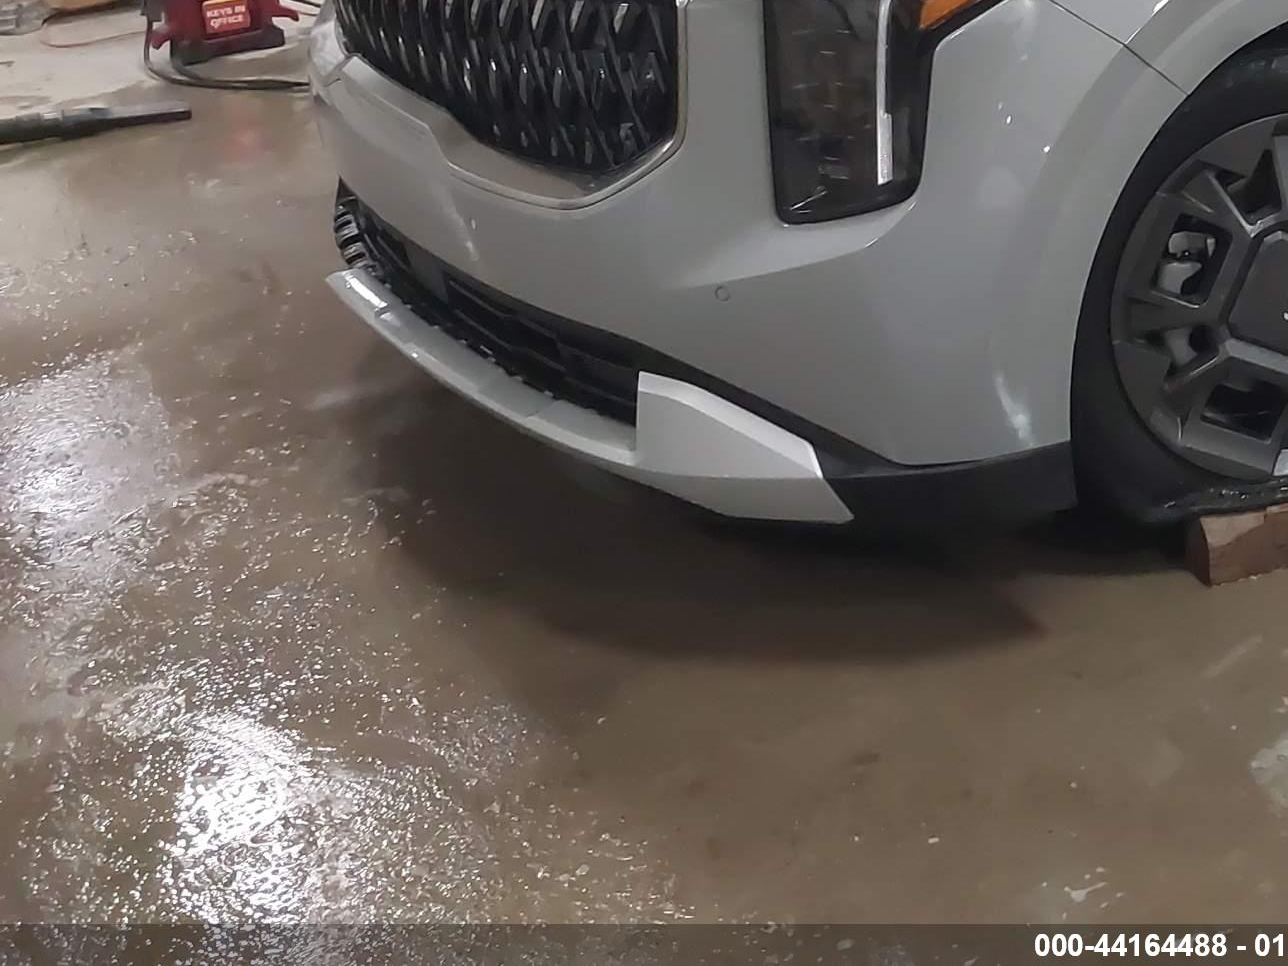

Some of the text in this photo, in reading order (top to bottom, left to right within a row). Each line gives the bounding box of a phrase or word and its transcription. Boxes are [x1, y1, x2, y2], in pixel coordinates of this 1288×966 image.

[206, 5, 246, 18] KEYS IN
[210, 14, 244, 28] OFFICE
